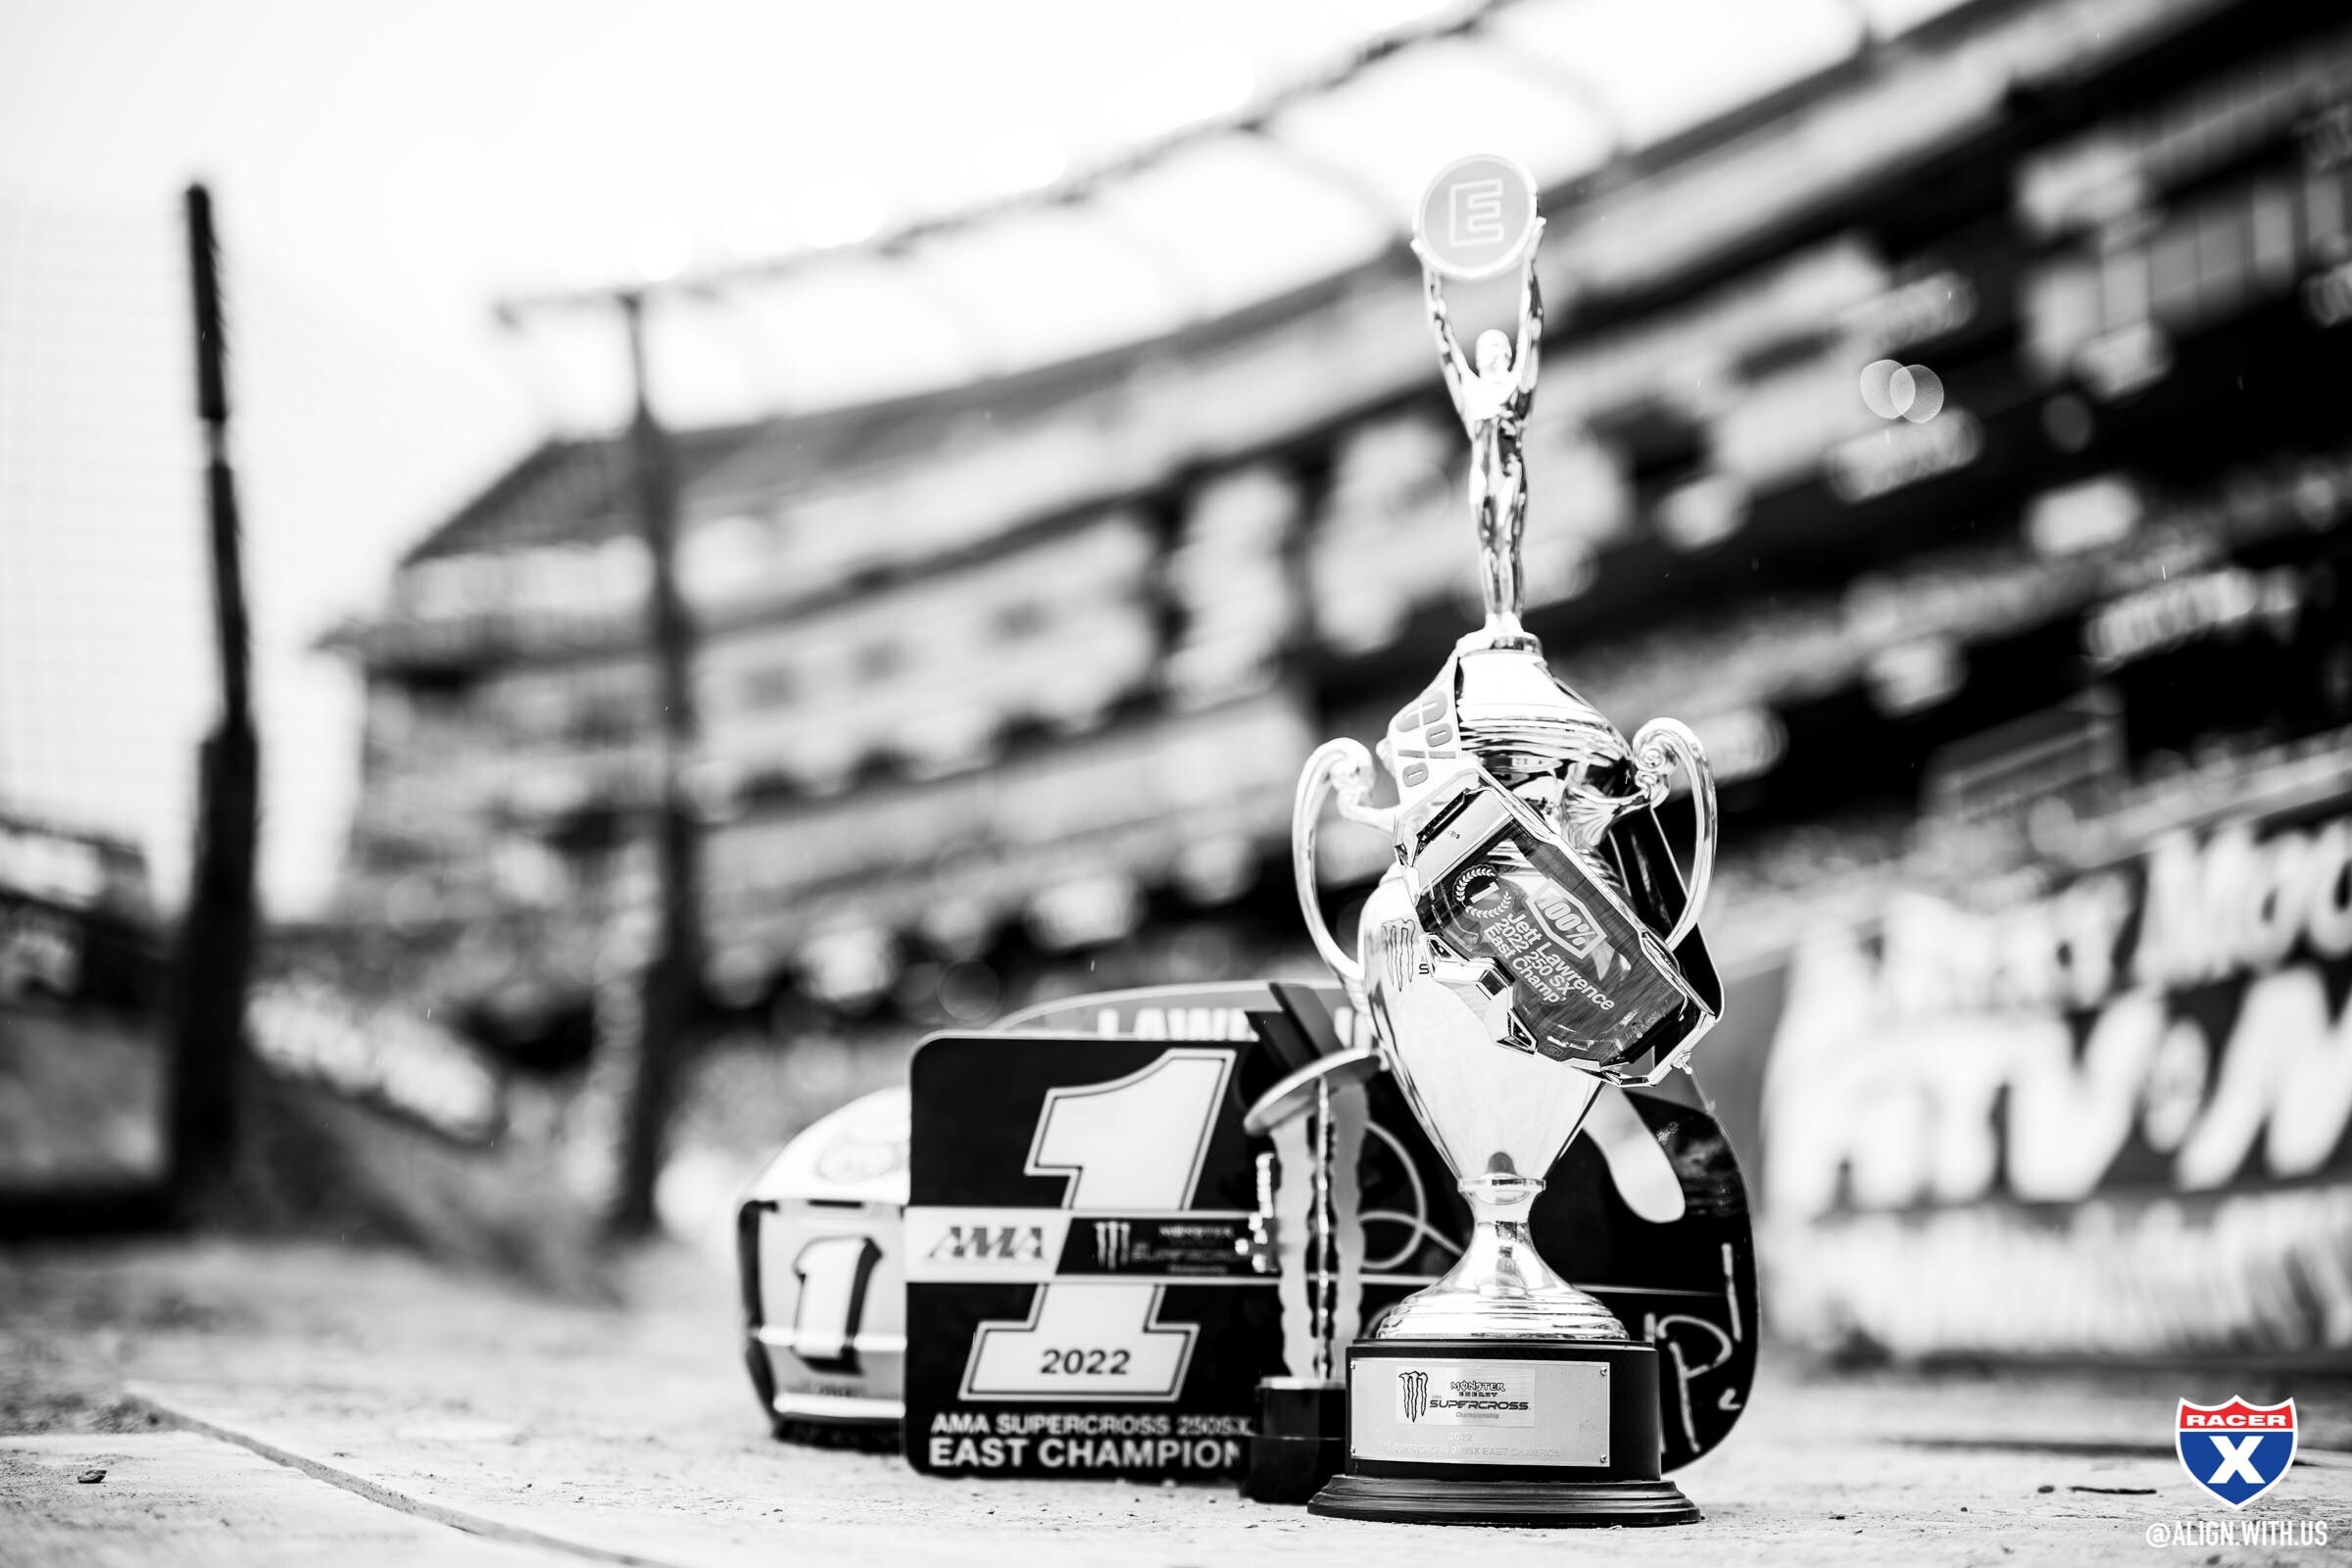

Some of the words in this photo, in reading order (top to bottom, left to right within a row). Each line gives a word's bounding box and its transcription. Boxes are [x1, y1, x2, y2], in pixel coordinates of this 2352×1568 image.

[1537, 899, 1595, 947] 100%
[1484, 924, 1516, 959] East
[1494, 918, 1530, 954] 2022
[1524, 951, 1553, 977] 250
[1549, 974, 1576, 996] SX
[1507, 912, 1543, 946] Jett
[1536, 942, 1615, 1010] Lawrence
[924, 1226, 1044, 1259] AMA
[1040, 1348, 1132, 1375] 2022
[1450, 1380, 1505, 1392] MONSTER
[1429, 1399, 1529, 1411] SUPERCROSS
[1455, 1411, 1500, 1420] Championship
[931, 1412, 991, 1436] AMA
[996, 1413, 1171, 1437] SUPERCROSS
[928, 1437, 1029, 1468] EAST
[1483, 1446, 1508, 1456] EAST
